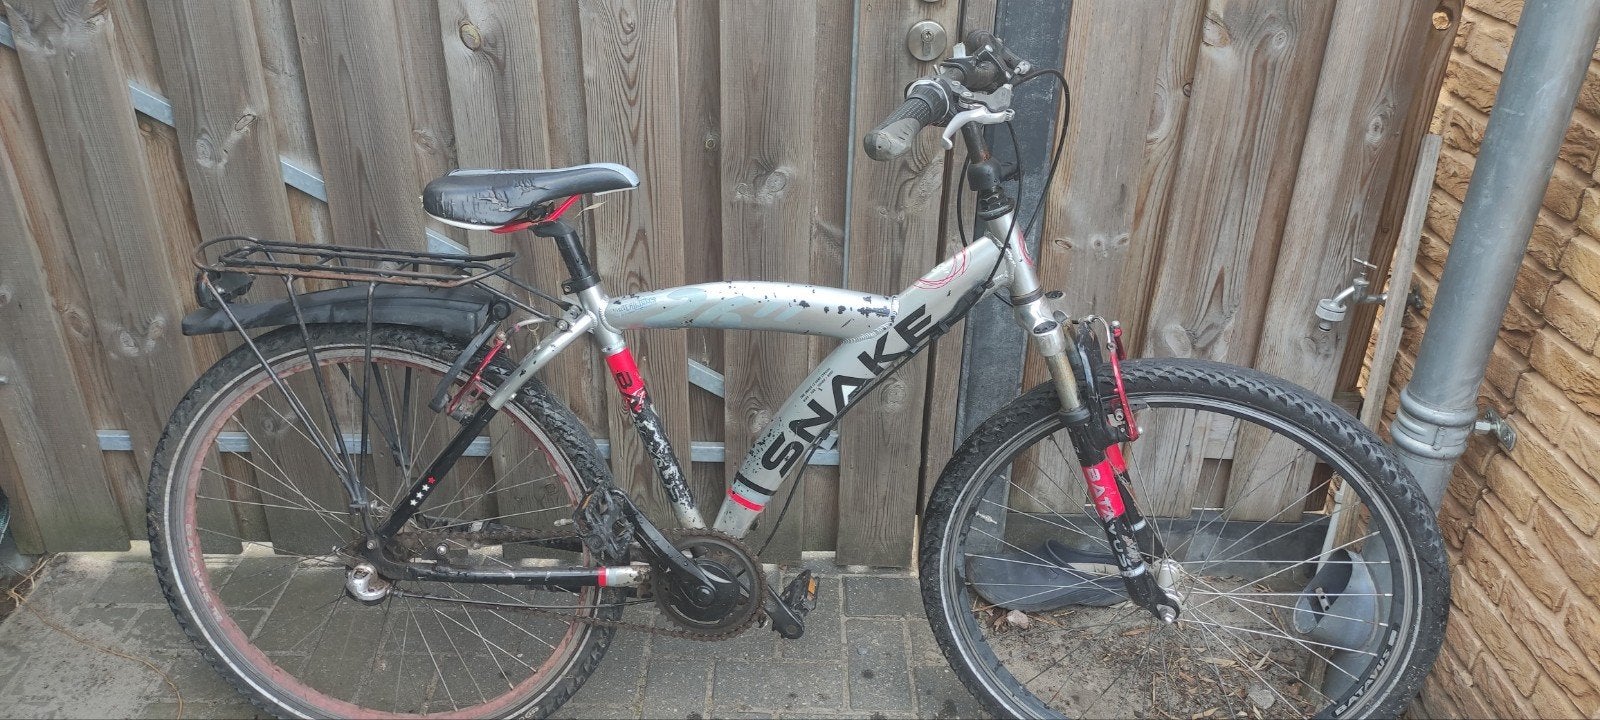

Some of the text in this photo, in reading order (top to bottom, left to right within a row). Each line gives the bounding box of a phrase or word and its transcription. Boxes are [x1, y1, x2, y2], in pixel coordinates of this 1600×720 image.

[761, 304, 937, 478] SNAKE
[1087, 468, 1132, 567] BATAVUS
[1334, 648, 1391, 716] BATAVUS
